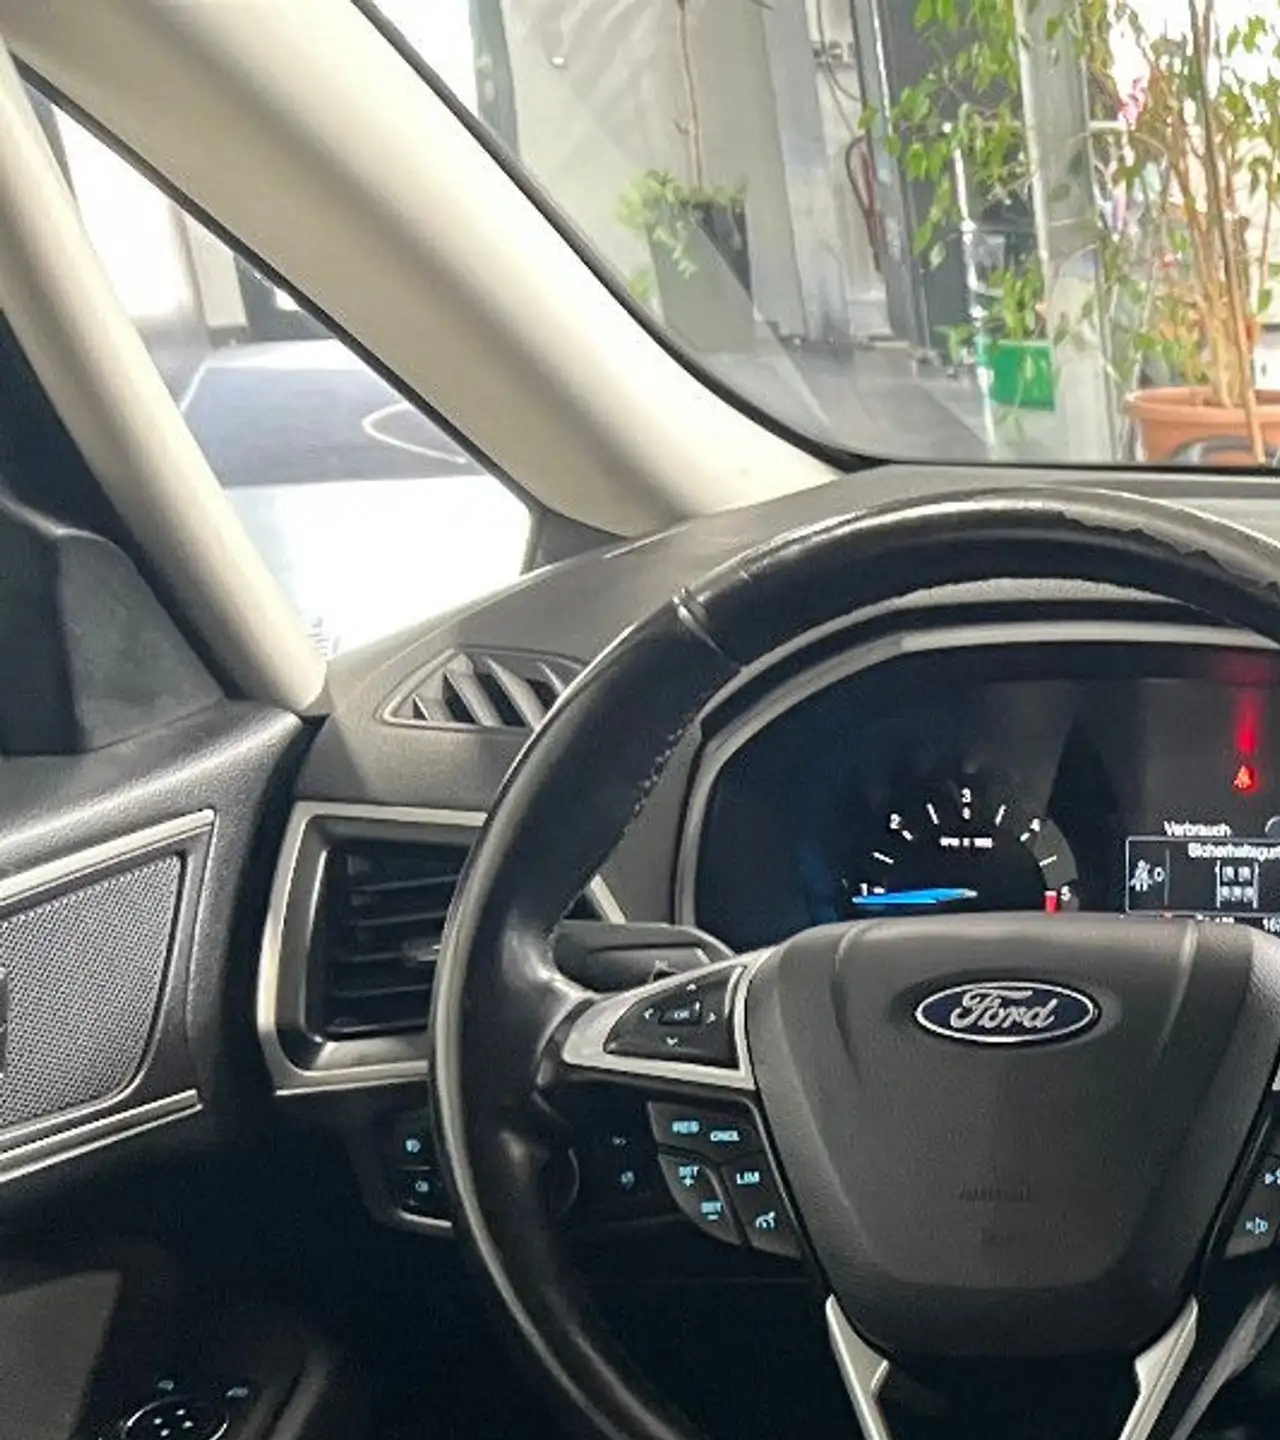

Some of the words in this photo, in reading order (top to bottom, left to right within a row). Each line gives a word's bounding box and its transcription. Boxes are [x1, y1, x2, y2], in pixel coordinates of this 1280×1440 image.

[962, 788, 972, 803] 3
[889, 813, 902, 830] 2
[1030, 818, 1041, 832] 4
[1164, 821, 1231, 837] Verbrauch
[950, 989, 1058, 1028] Ford
